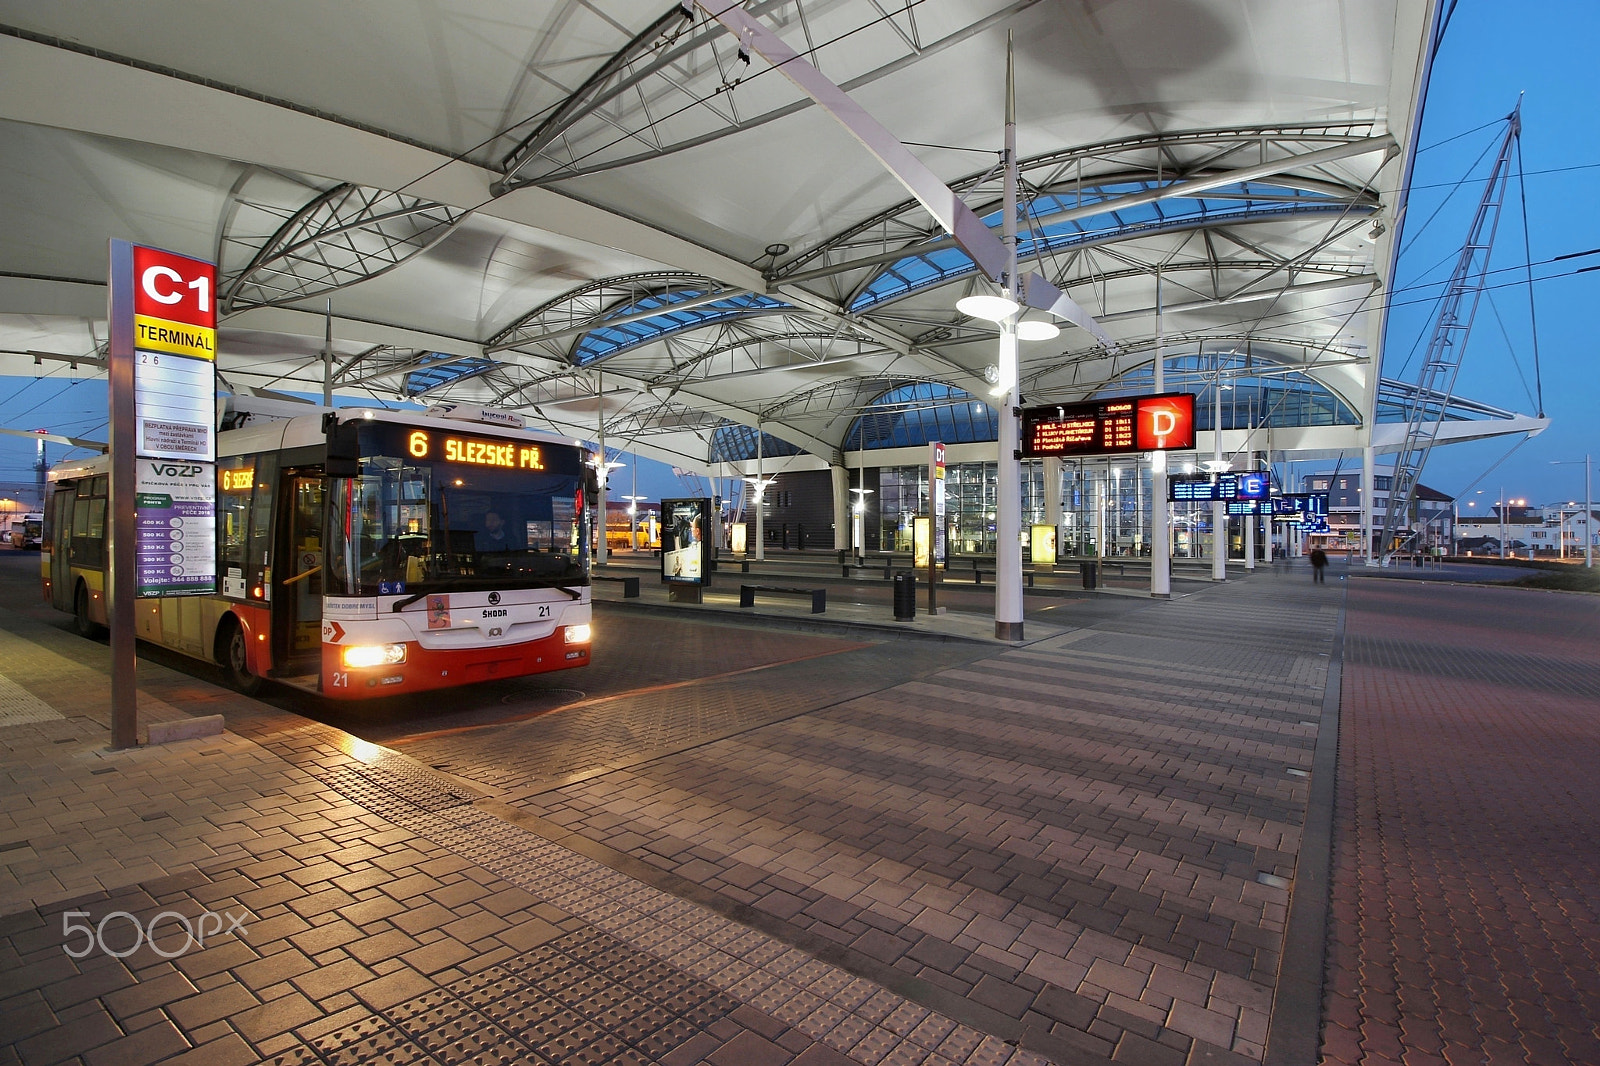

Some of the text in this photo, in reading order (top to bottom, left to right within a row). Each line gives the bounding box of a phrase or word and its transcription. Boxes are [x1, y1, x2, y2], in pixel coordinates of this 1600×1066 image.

[142, 266, 209, 312] C1
[138, 323, 212, 351] TERMINÁL
[142, 354, 159, 365] 2 6
[145, 422, 172, 430] BEZPLATNÁ
[173, 424, 197, 433] PŘEPRAVA
[1152, 410, 1176, 436] D
[409, 431, 545, 470] 6 SLEZSKÉ PŘ.
[936, 448, 945, 463] D1
[223, 470, 231, 490] 6
[1247, 479, 1260, 493] E
[143, 577, 171, 585] Volejte:
[482, 608, 508, 618] ŠKODA
[538, 605, 551, 618] 21
[333, 672, 349, 688] 21
